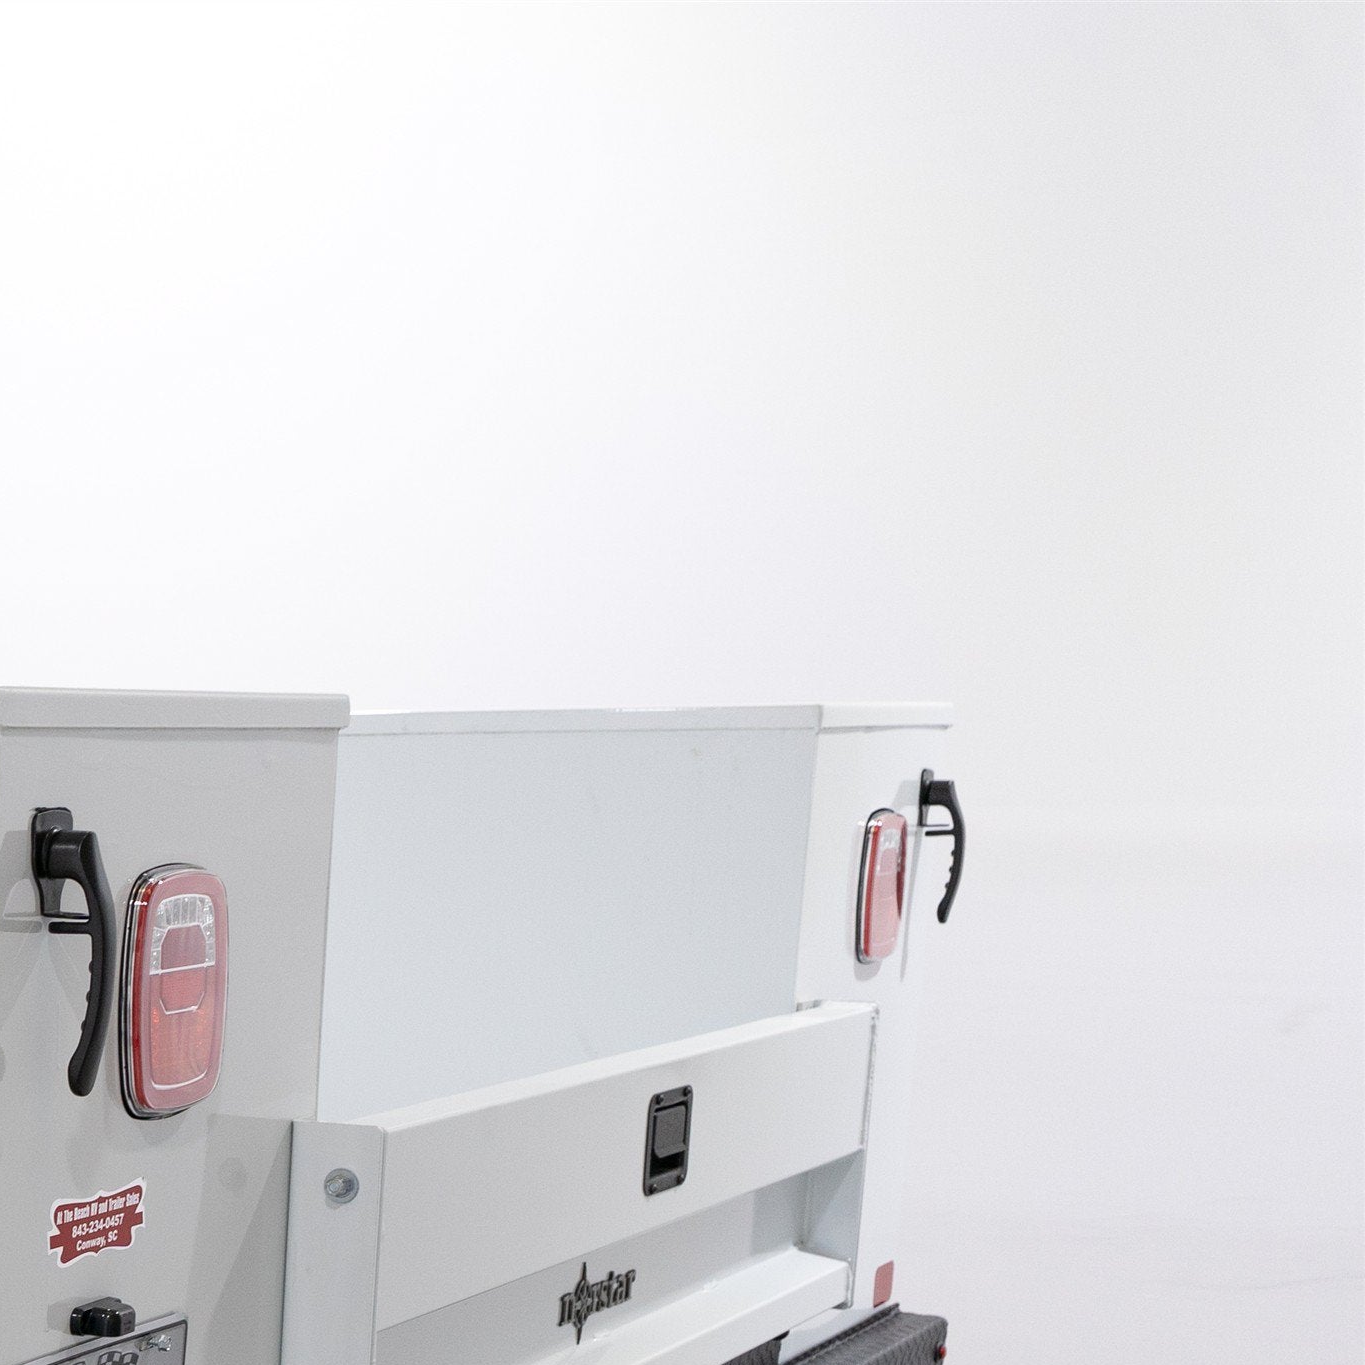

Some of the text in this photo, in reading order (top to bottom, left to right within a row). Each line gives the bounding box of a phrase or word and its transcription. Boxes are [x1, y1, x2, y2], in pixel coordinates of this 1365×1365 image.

[98, 1199, 108, 1214] and
[108, 1196, 126, 1212] Trailer
[126, 1192, 140, 1207] Sales
[71, 1213, 124, 1238] 843-234-0457
[76, 1230, 118, 1251] Conway, SC
